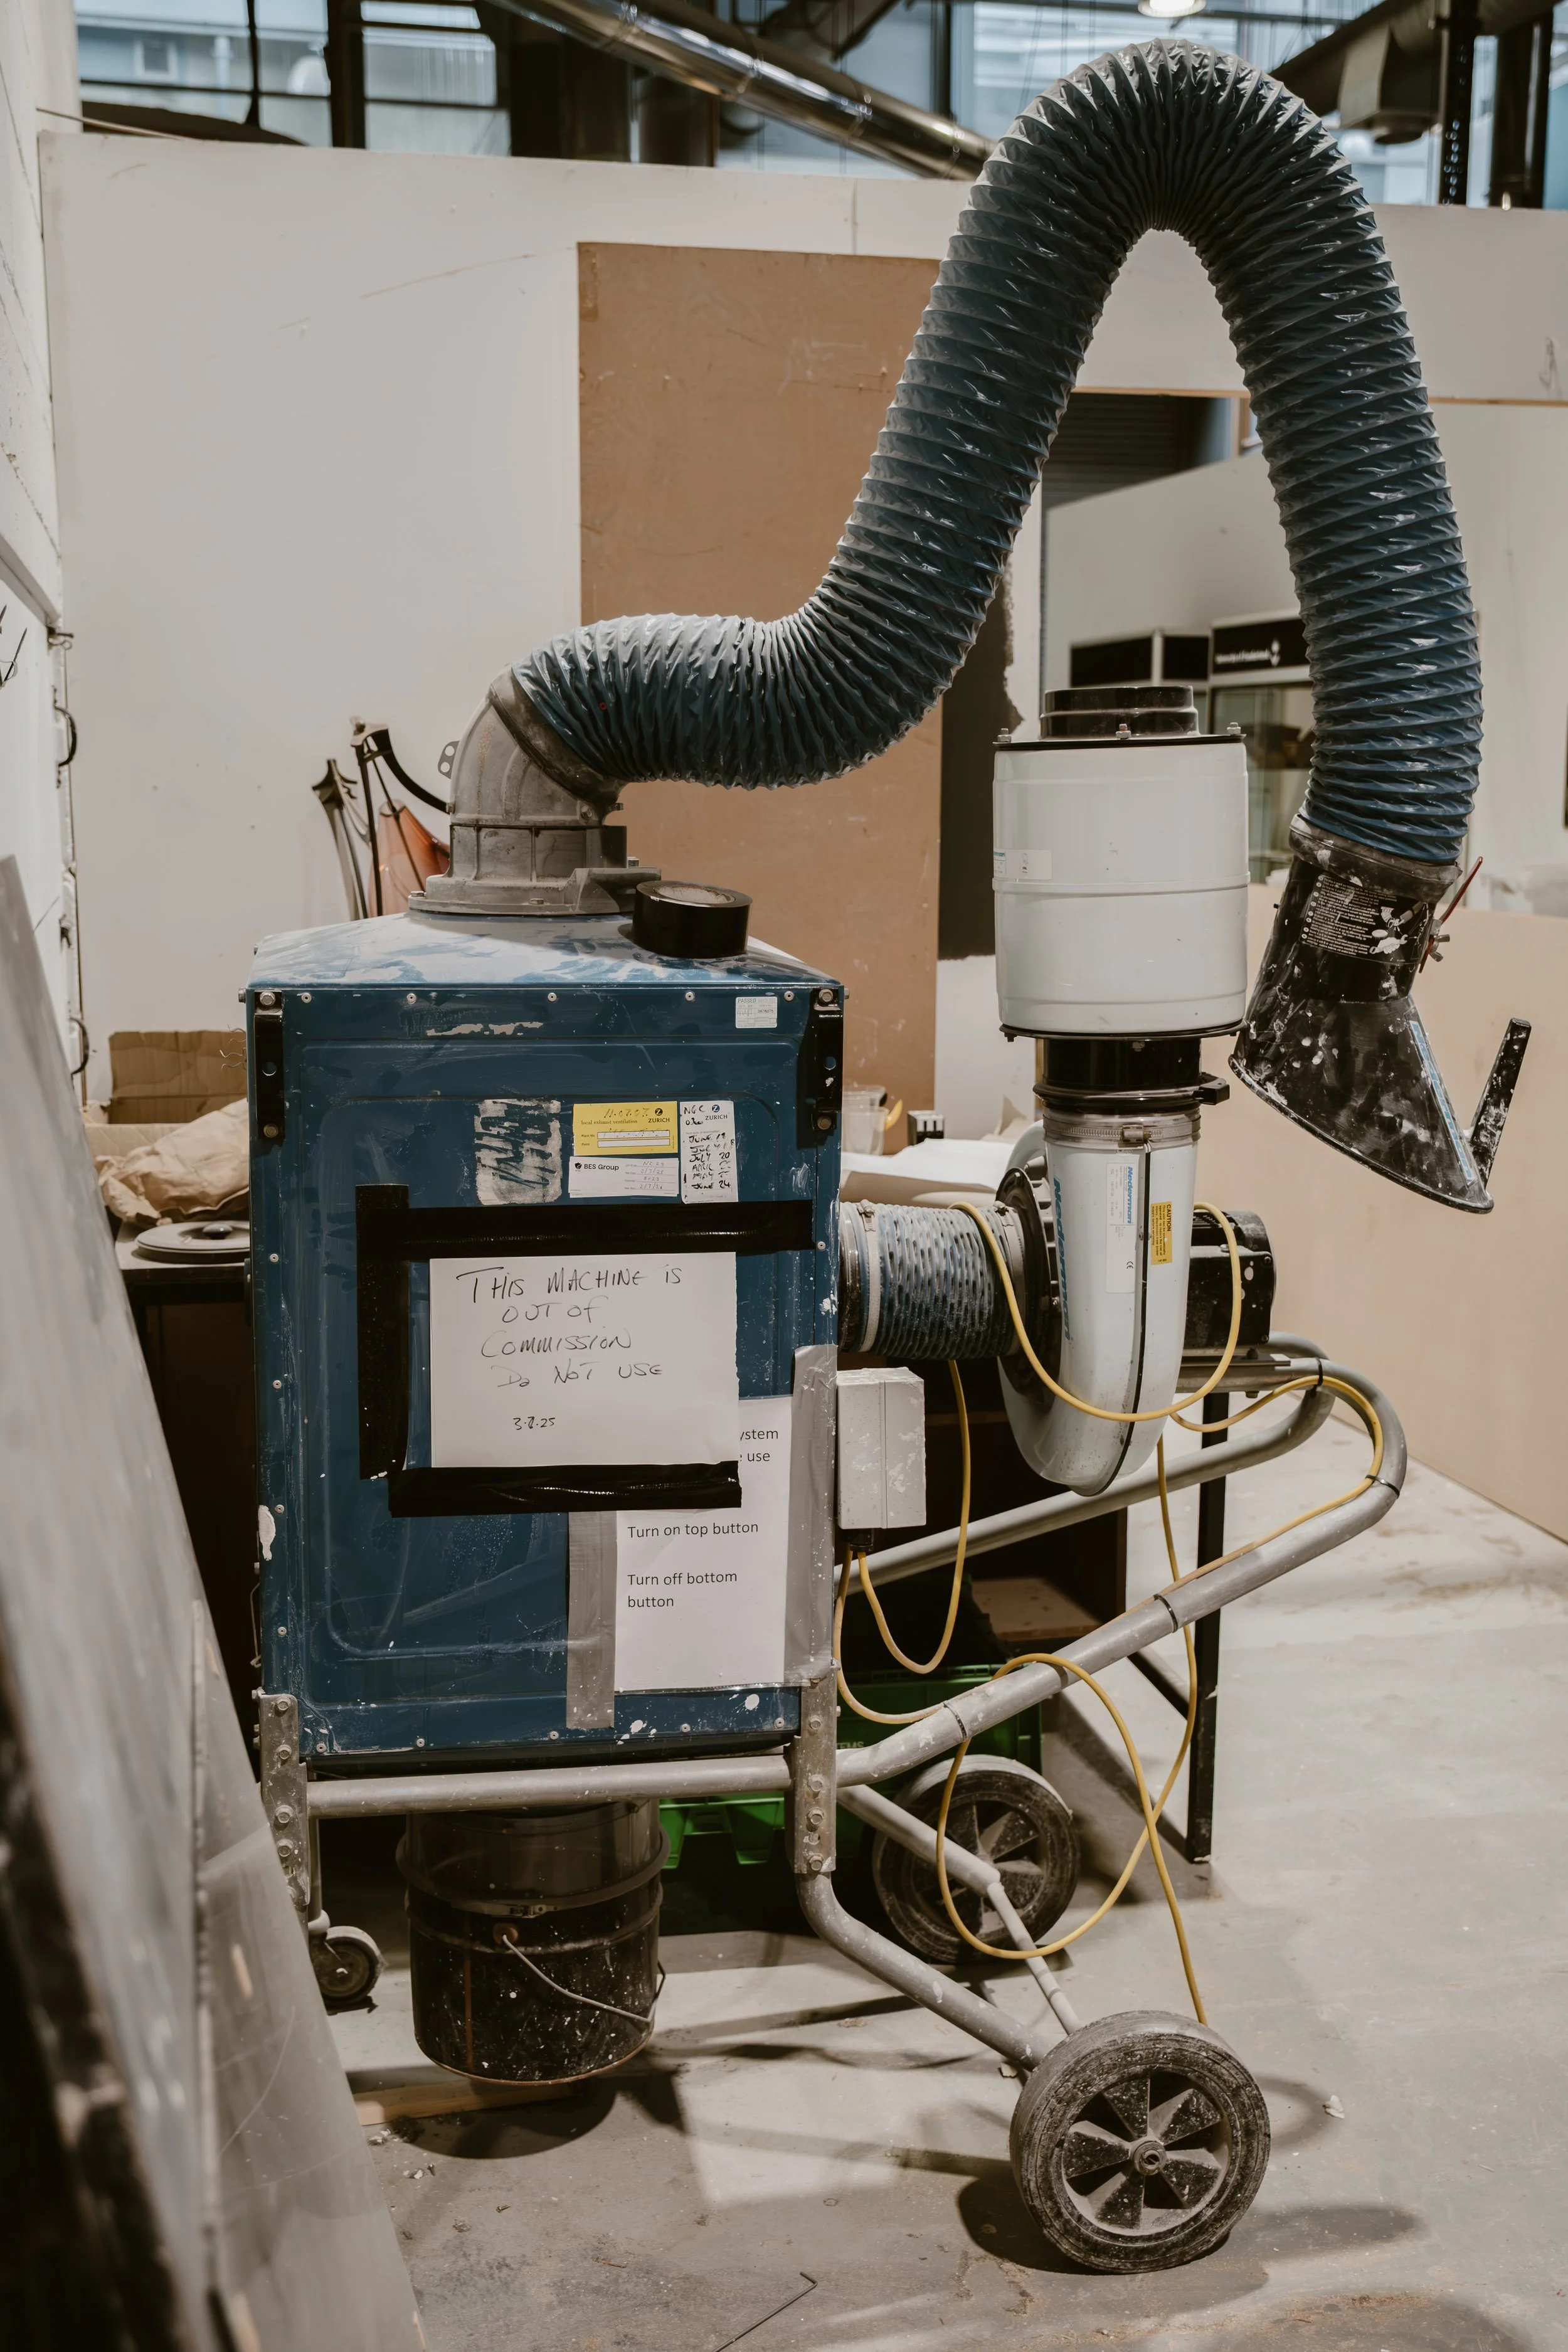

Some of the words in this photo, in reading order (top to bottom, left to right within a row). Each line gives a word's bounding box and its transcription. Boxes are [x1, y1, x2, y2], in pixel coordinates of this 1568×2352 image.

[719, 1152, 730, 1160] 20
[719, 1180, 730, 1189] 24
[1053, 1177, 1071, 1341] Nederman
[548, 1267, 648, 1299] MACHINE
[502, 1303, 554, 1323] OUT
[481, 1328, 632, 1360] COMMISSION
[618, 1364, 664, 1379] USE
[747, 1453, 771, 1462] use
[627, 1526, 659, 1538] Turn
[664, 1526, 681, 1536] on
[685, 1524, 708, 1538] top
[713, 1522, 758, 1535] button
[627, 1574, 659, 1586] Turn
[664, 1571, 682, 1585] off
[687, 1571, 737, 1584] bottom
[628, 1596, 674, 1608] button
